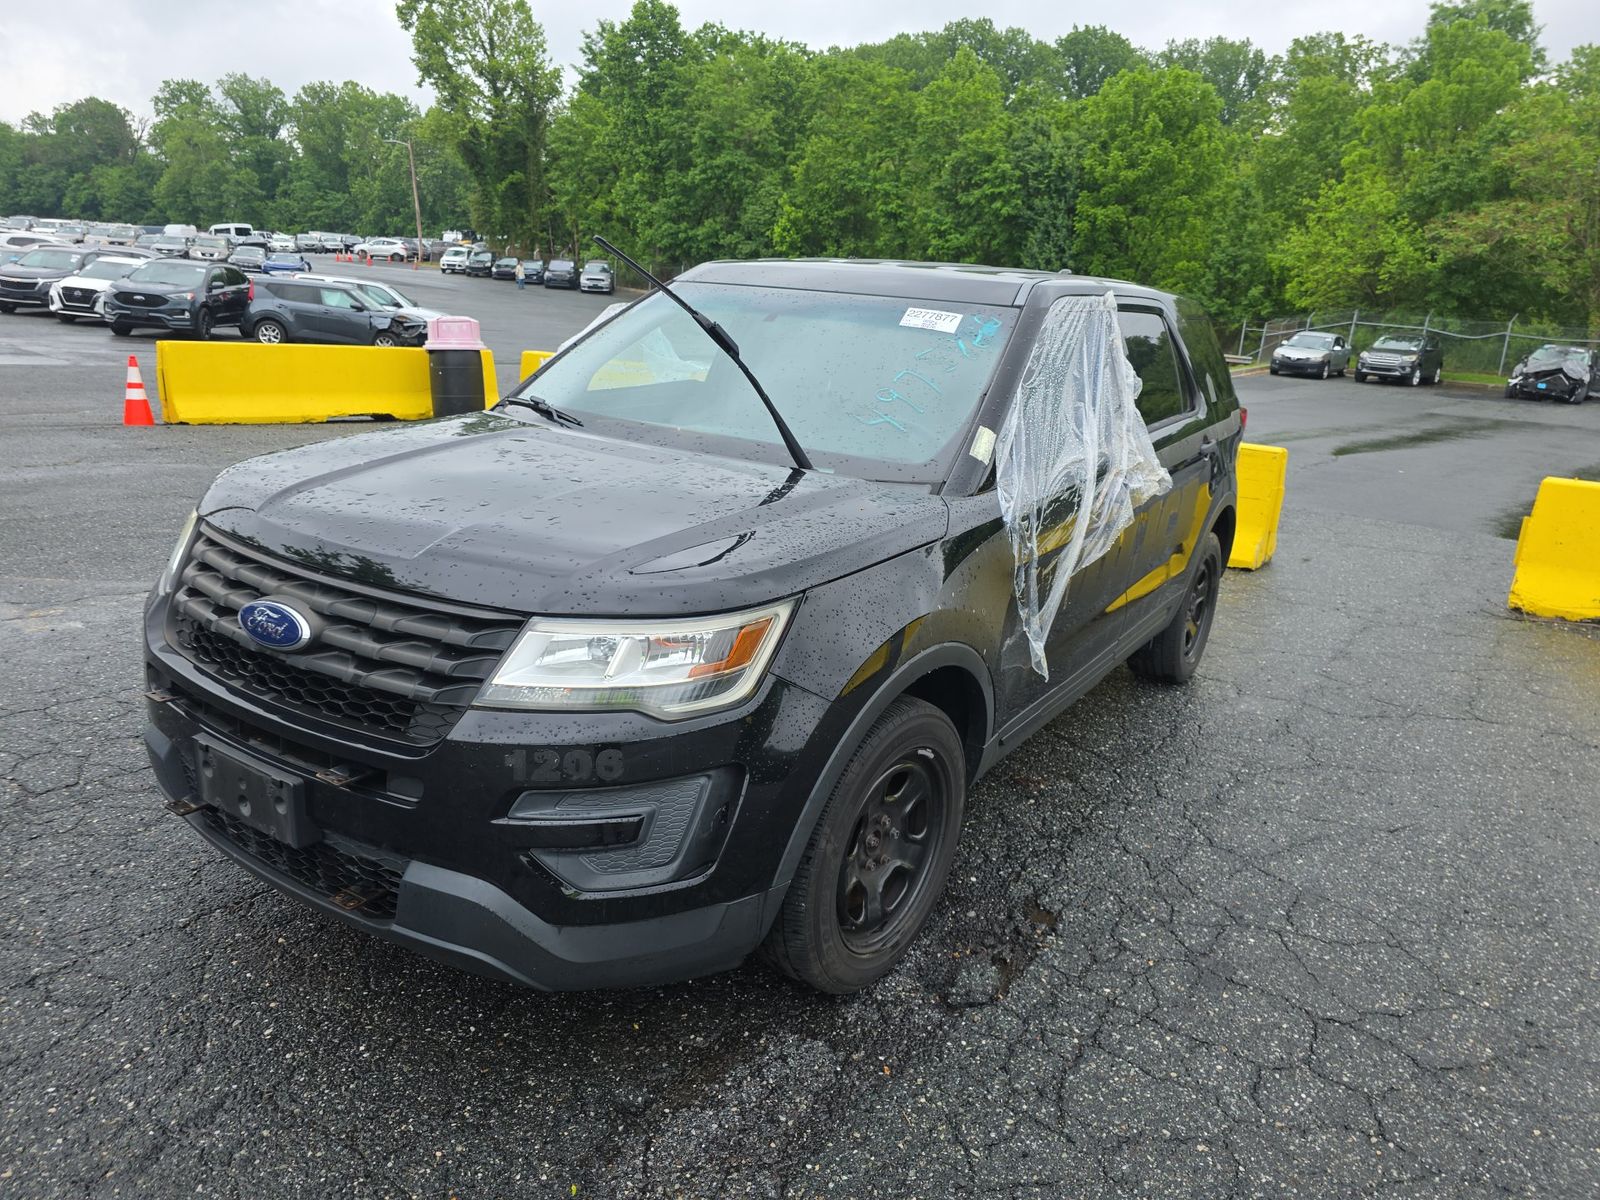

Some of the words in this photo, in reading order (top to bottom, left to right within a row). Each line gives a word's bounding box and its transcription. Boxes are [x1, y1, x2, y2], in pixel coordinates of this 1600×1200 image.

[906, 309, 958, 323] 2277877
[247, 607, 289, 639] Ford
[504, 748, 625, 781] 1206
